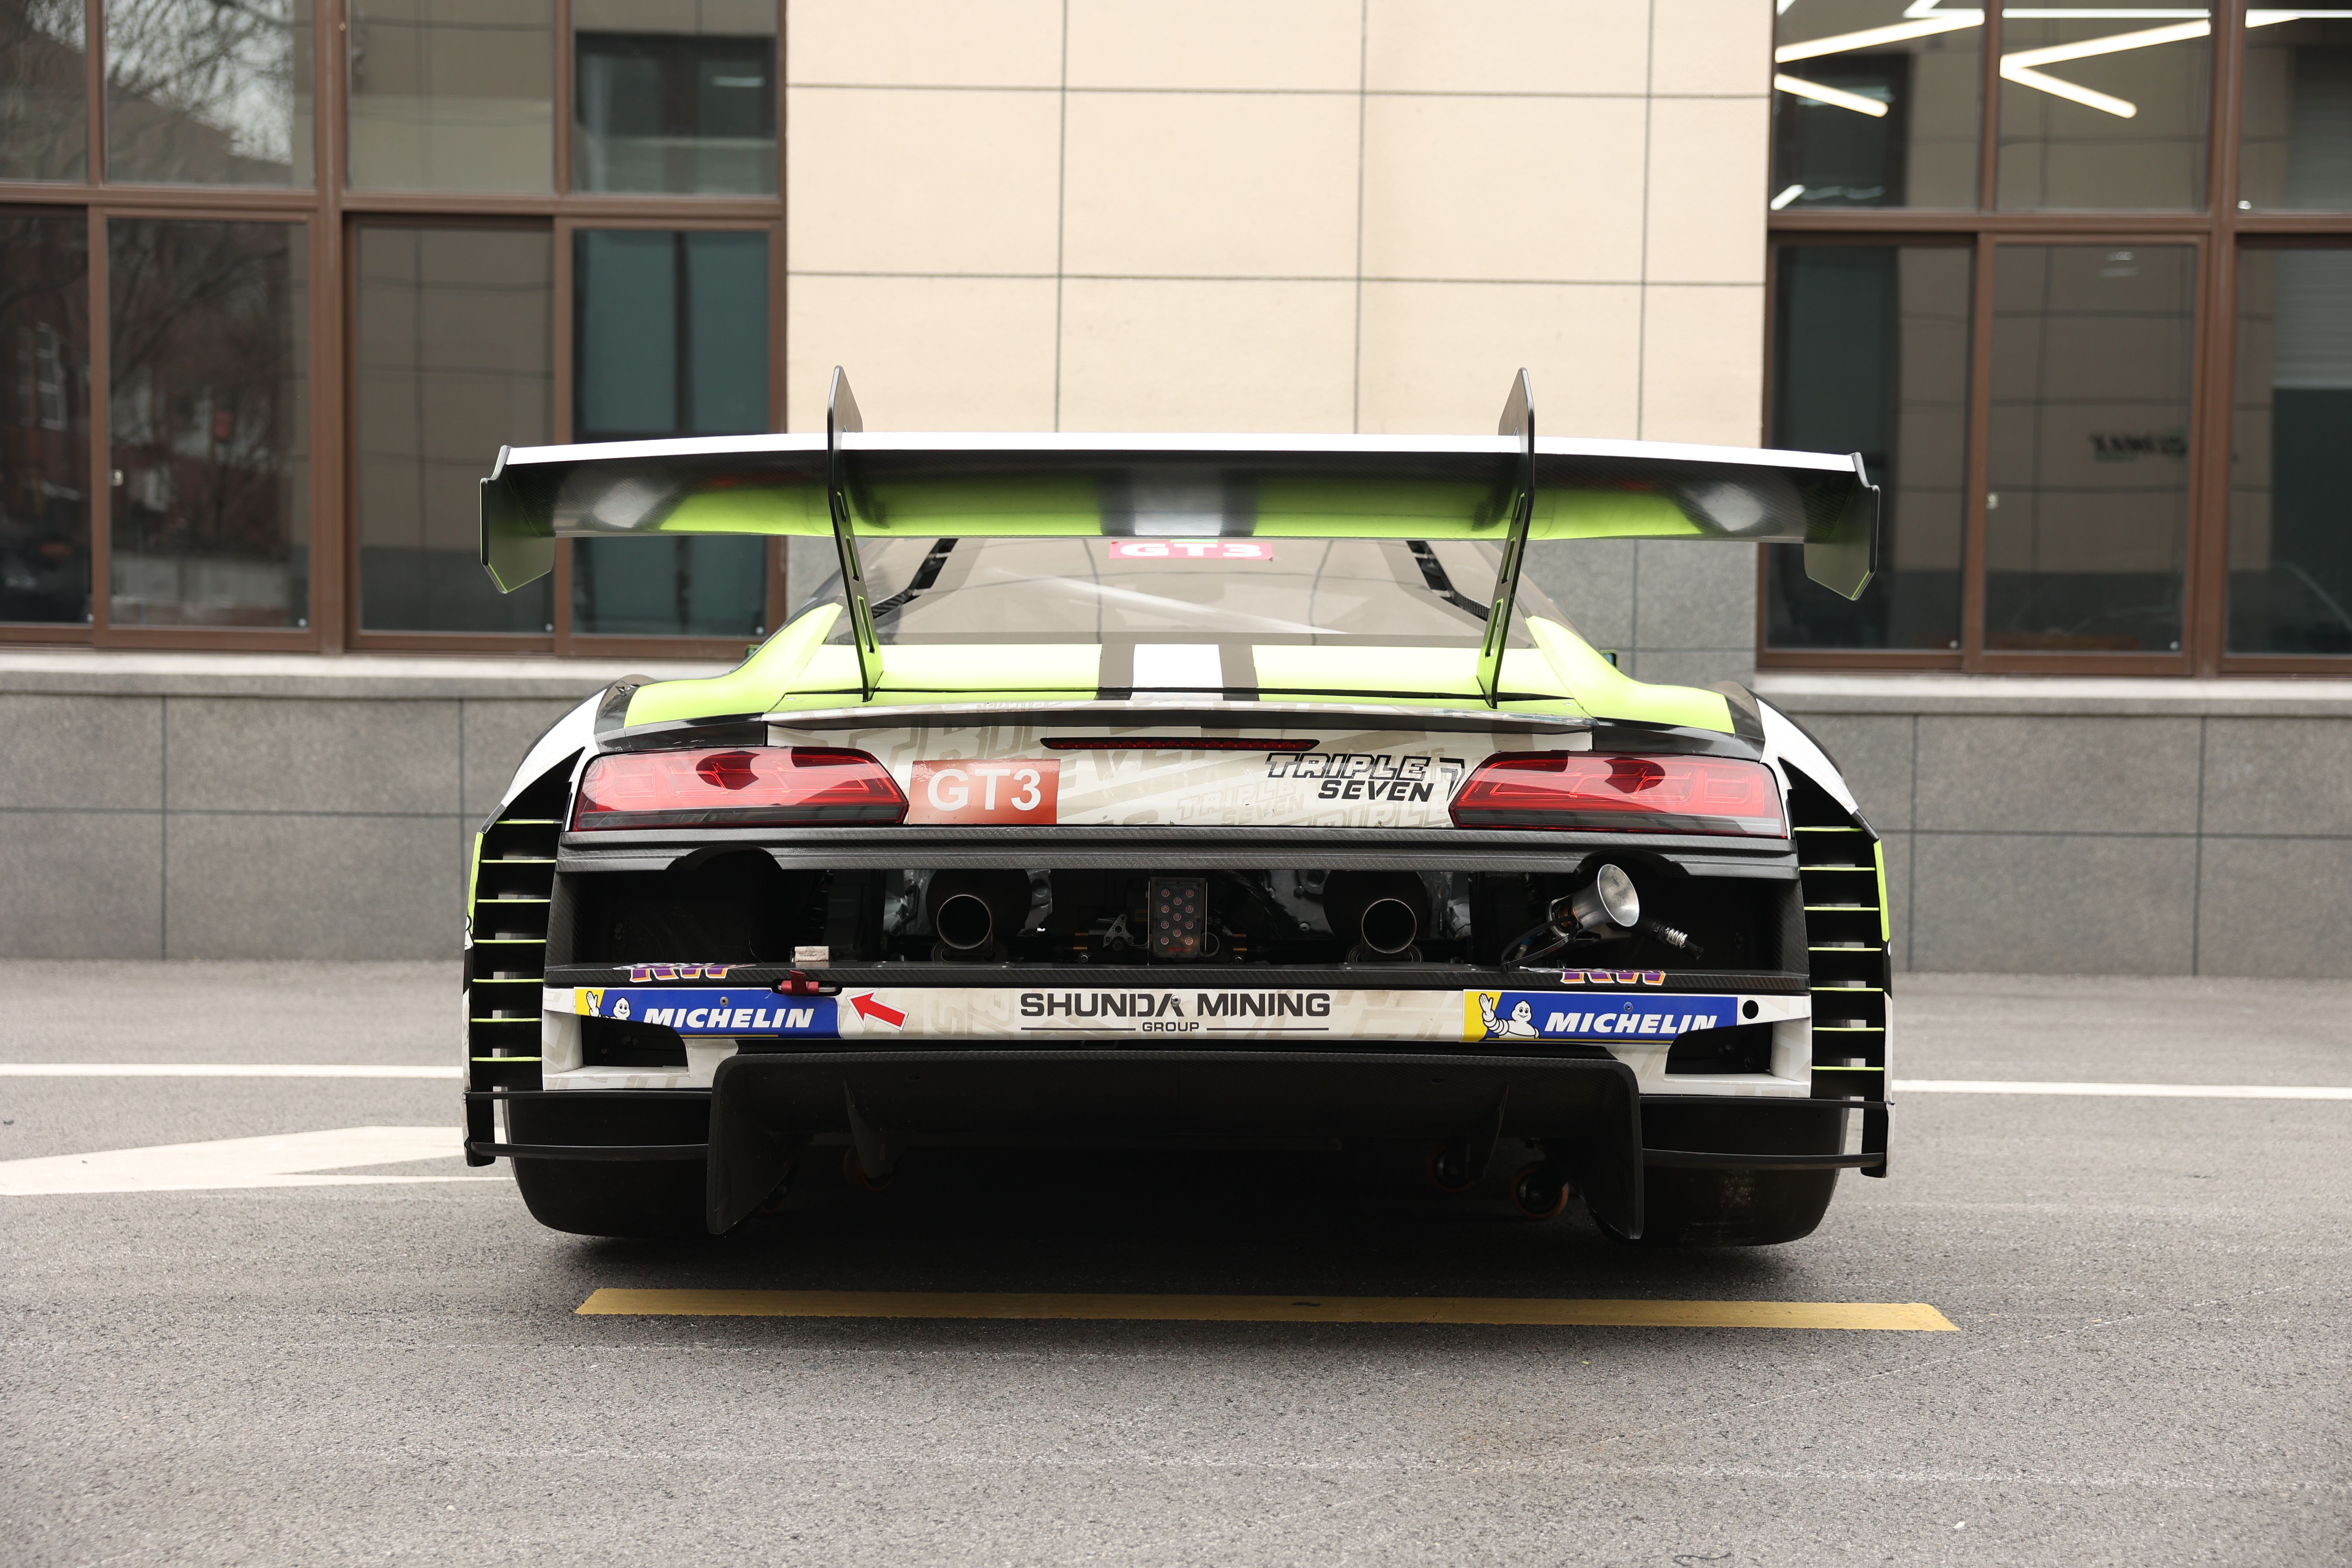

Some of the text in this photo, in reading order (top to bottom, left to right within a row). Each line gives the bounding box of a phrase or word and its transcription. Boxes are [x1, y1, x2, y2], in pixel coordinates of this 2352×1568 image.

[1120, 543, 1262, 557] GT3
[1265, 753, 1432, 781] TRIPLE
[927, 769, 1041, 812] GT3
[1176, 778, 1298, 821] TRIPLE
[1317, 779, 1434, 802] SEVEN
[1220, 793, 1305, 826] SEVEN
[1021, 993, 1330, 1017] SHUNDA MINING
[643, 1008, 814, 1028] MICHELIN
[1142, 1022, 1199, 1032] GROUP
[1544, 1012, 1718, 1034] MICHELIN
